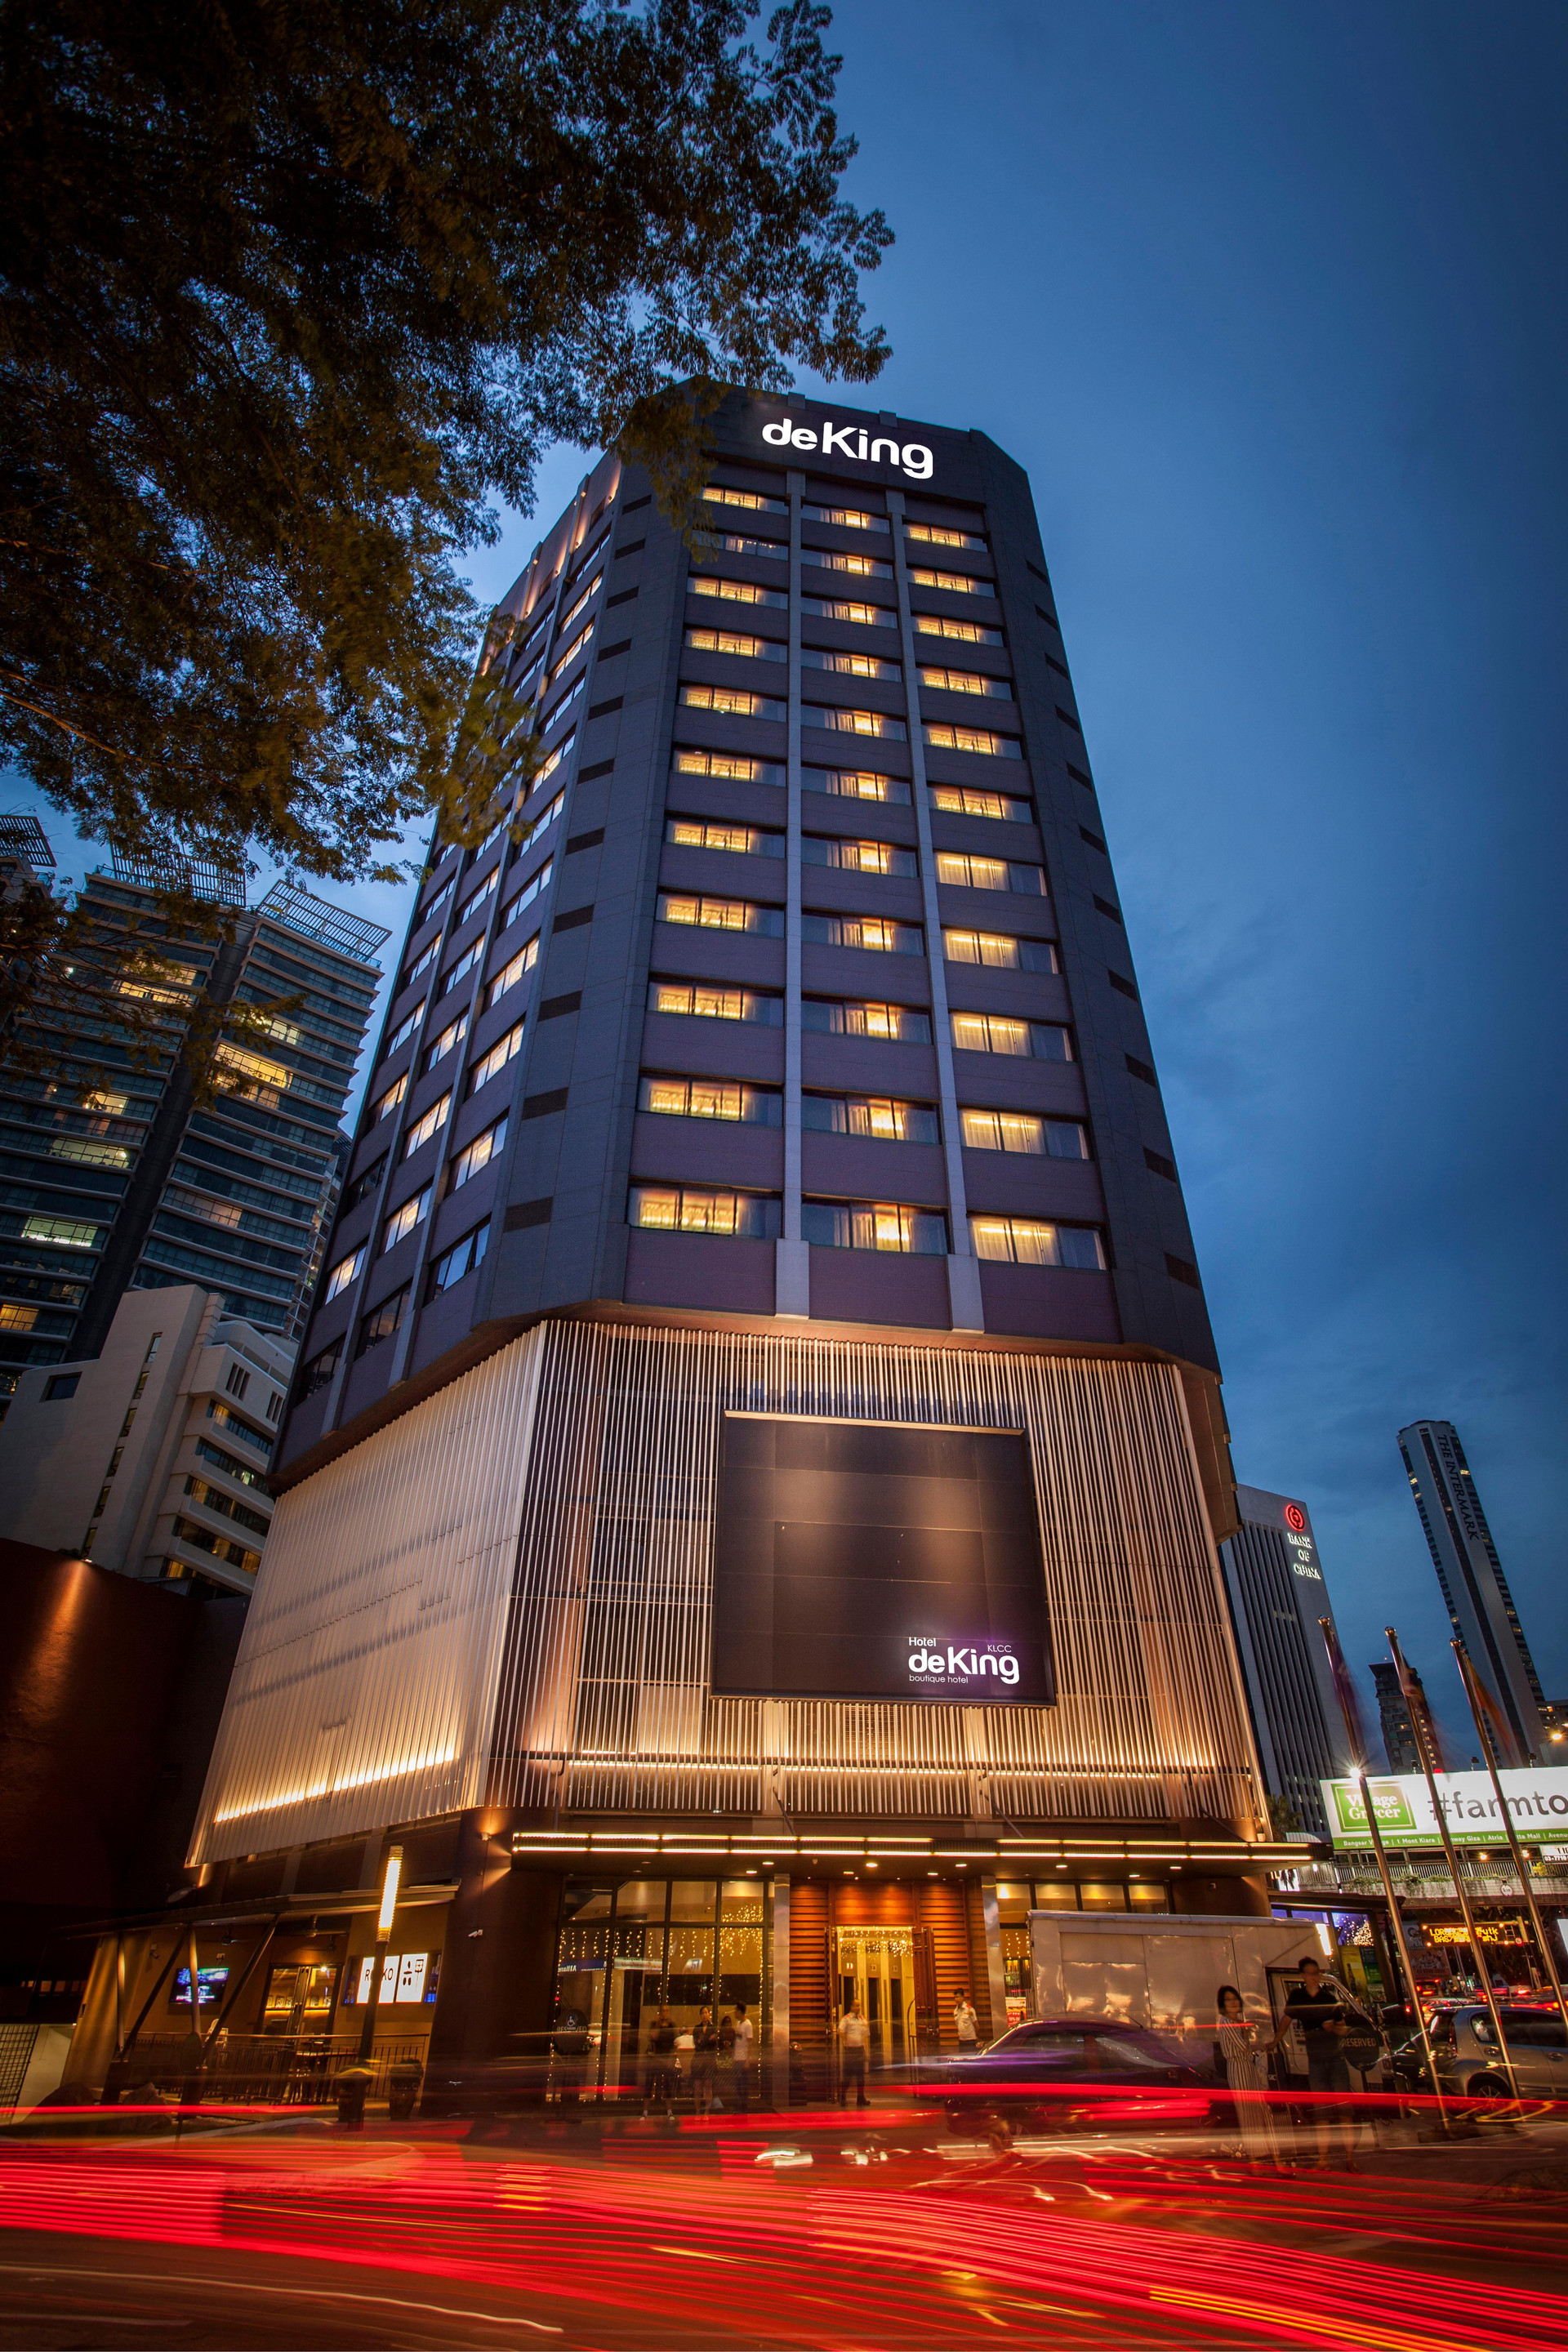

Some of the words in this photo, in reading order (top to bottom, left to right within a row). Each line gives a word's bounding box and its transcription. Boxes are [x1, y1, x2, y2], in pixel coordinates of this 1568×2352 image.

[1437, 1434, 1453, 1459] THE
[1446, 1460, 1479, 1540] INTERMARK
[1287, 1533, 1312, 1548] BANK
[1298, 1550, 1309, 1561] OF
[1294, 1563, 1321, 1579] CHINA
[908, 1637, 937, 1646] Hotel
[987, 1644, 1012, 1653] KLCC
[909, 1674, 946, 1683] boutique
[947, 1675, 969, 1683] hotel
[1346, 1794, 1398, 1808] Viage
[1348, 1806, 1401, 1820] Grcer
